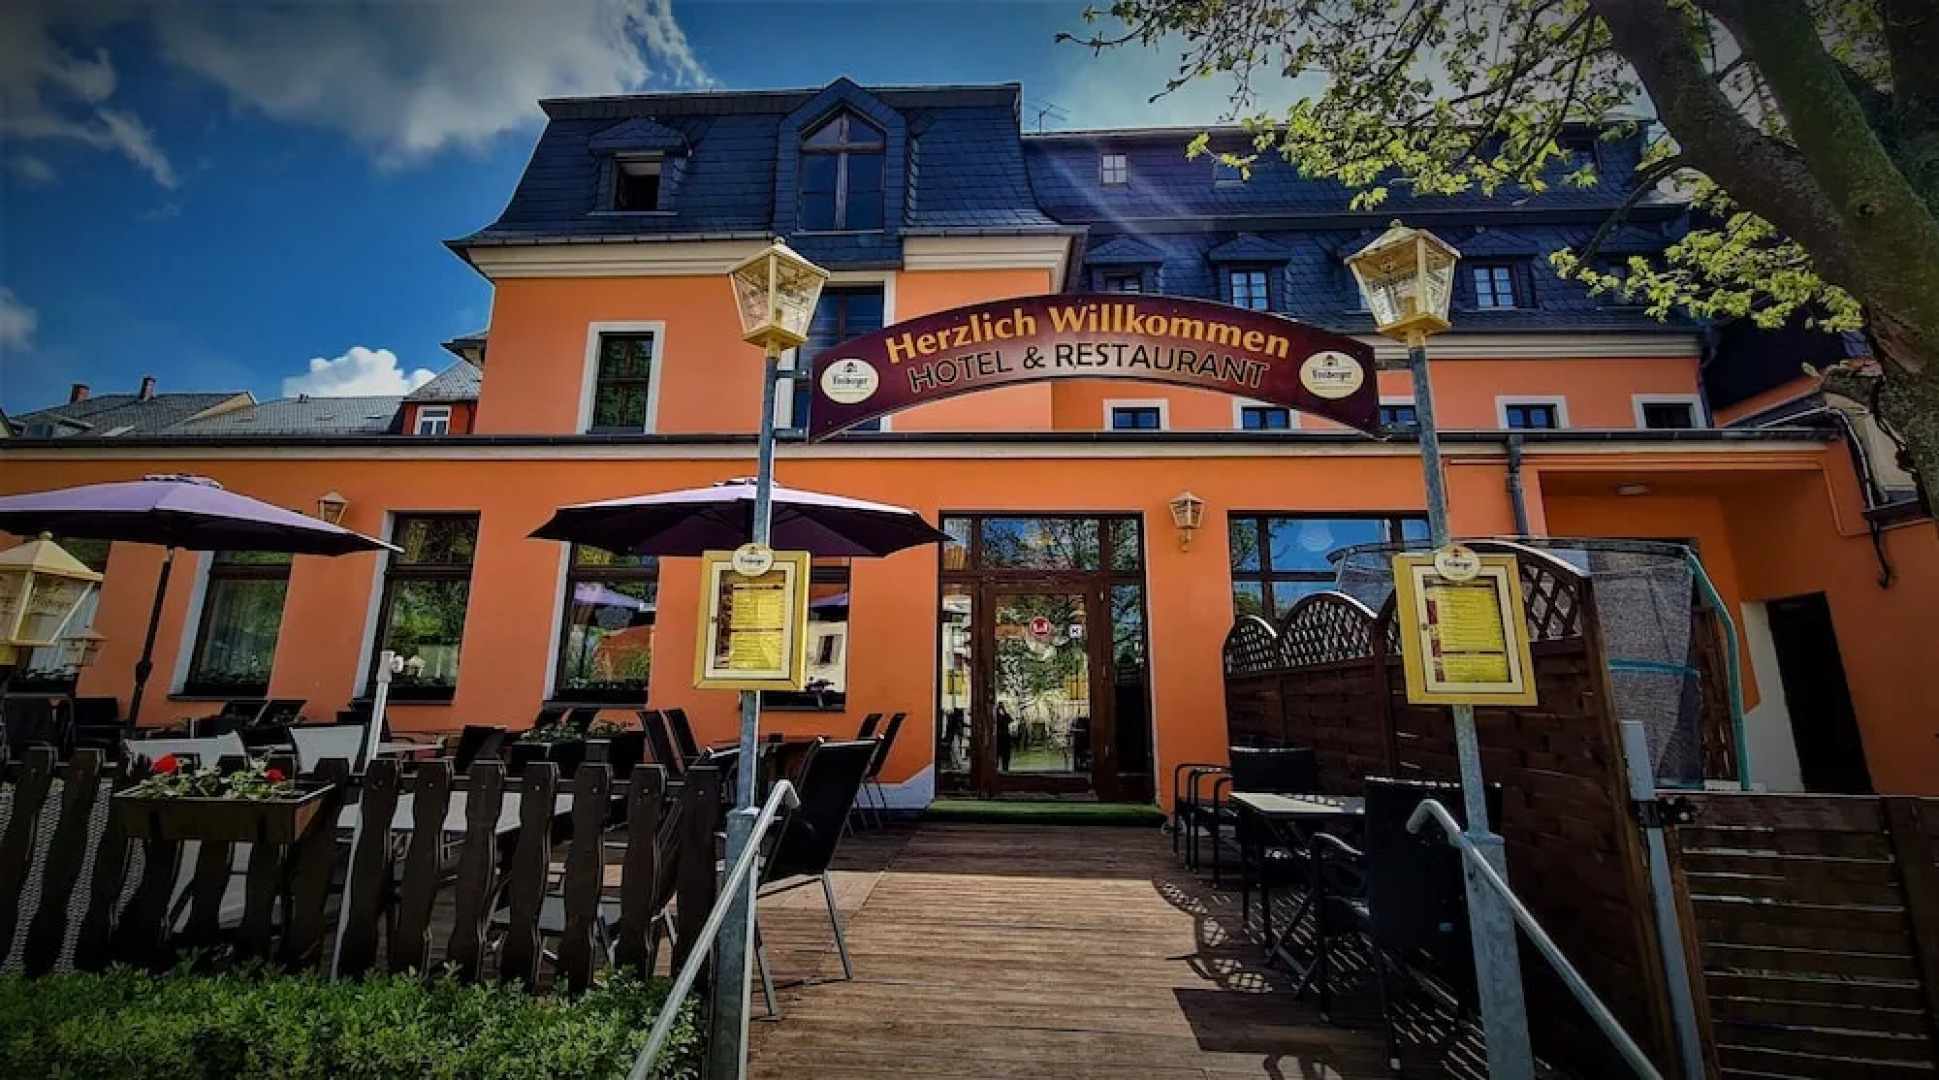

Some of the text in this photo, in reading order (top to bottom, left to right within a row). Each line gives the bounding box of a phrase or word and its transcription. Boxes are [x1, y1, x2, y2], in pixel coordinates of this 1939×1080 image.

[886, 303, 1290, 364] Herzlich Willkommen
[908, 342, 1270, 393] HOTEL & RESTAURANT
